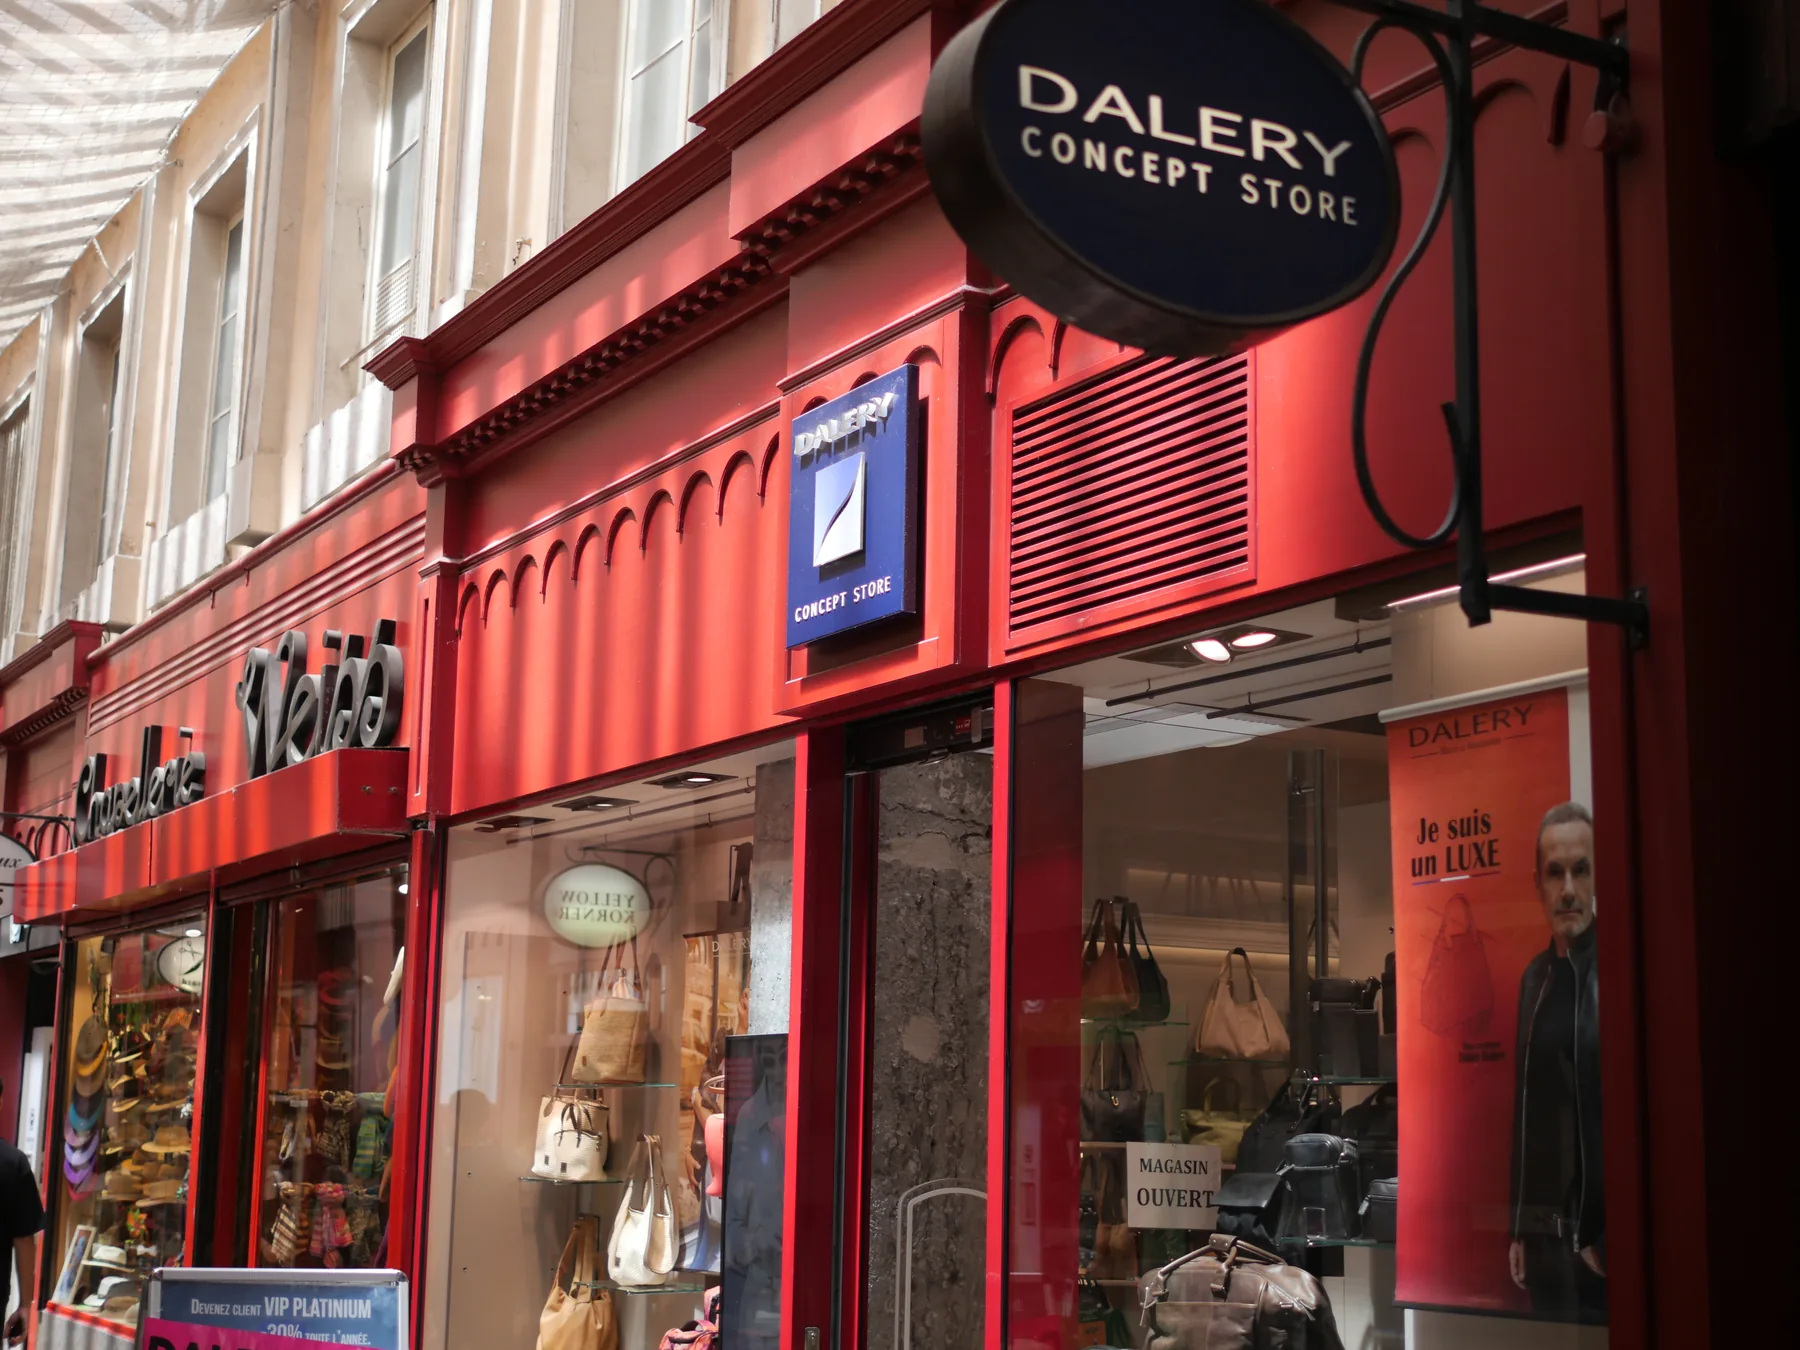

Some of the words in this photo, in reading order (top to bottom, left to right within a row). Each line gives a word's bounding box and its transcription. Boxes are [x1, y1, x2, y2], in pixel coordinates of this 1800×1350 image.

[1018, 64, 1352, 177] DALERY
[1021, 125, 1213, 194] CONCEPT
[1240, 172, 1358, 226] STORE
[794, 391, 896, 456] DALERY
[794, 591, 848, 623] CONCEPT
[853, 576, 892, 604] STORE
[1408, 702, 1535, 749] DALERY
[1416, 817, 1440, 845] Je
[1447, 808, 1492, 840] suis
[1411, 852, 1437, 878] un
[1446, 838, 1501, 873] LUXE
[1139, 1157, 1209, 1175] MAGASIN
[1136, 1187, 1214, 1208] OUVERT
[264, 1296, 290, 1317] VIP
[292, 1297, 372, 1319] PLATINIUM
